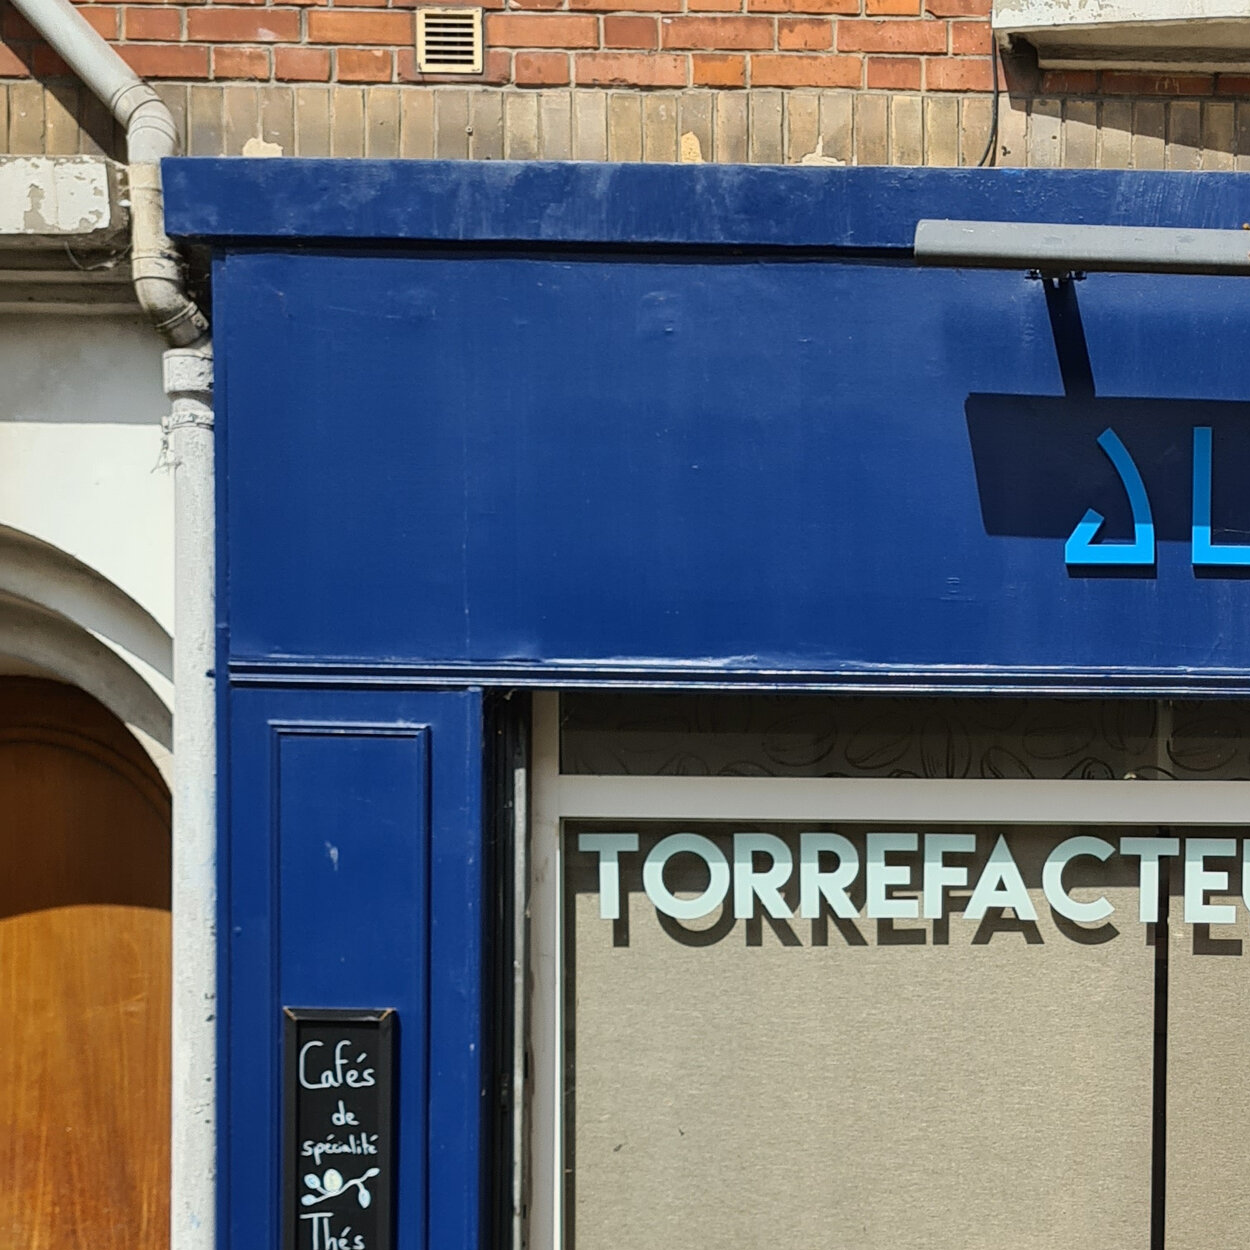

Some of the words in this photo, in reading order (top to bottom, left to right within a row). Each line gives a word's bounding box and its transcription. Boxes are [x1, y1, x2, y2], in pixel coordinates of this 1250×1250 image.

[300, 1040, 376, 1089] Cafés
[331, 1100, 360, 1126] de
[301, 1133, 379, 1165] spécialité
